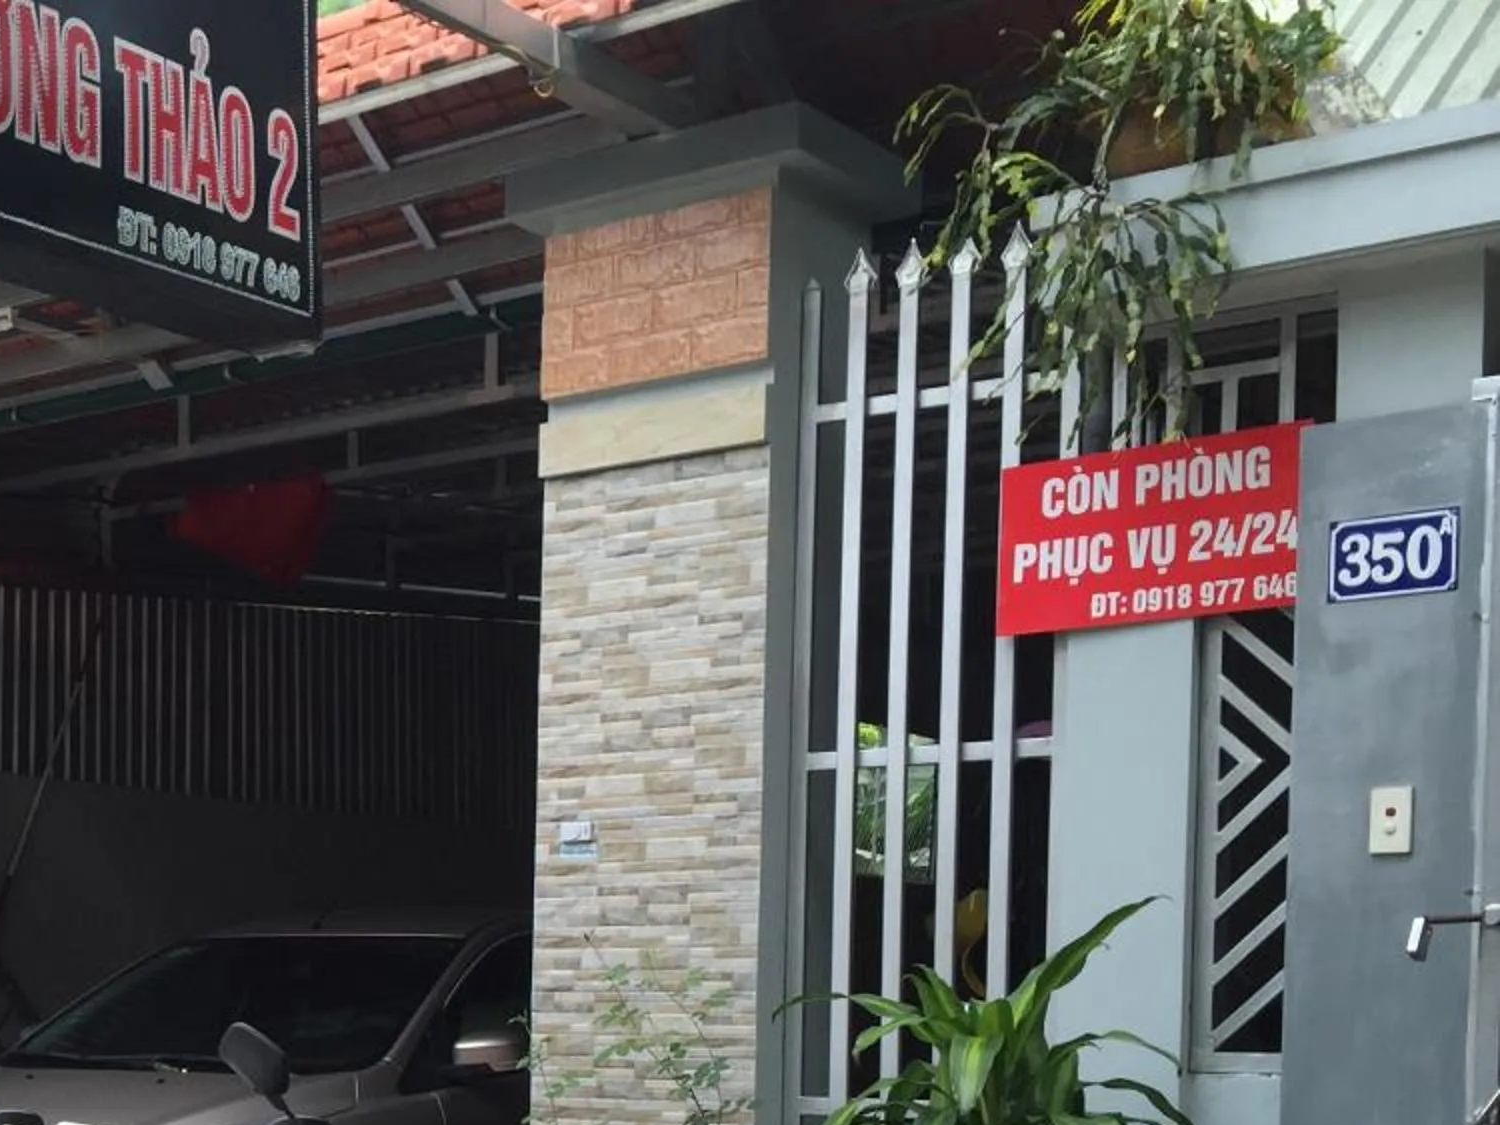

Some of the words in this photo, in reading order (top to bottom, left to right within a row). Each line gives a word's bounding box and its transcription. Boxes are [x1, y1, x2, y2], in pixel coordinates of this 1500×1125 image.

[114, 27, 256, 223] THẢO
[267, 108, 301, 241] 2
[220, 241, 260, 288] 977
[1041, 465, 1119, 519] CÒN
[1135, 446, 1271, 505] PHÒNG
[1012, 532, 1113, 586] PHỤC
[1127, 523, 1177, 575] VỤ
[1188, 509, 1298, 562] 24/24
[1132, 583, 1192, 613] 0918
[1200, 577, 1245, 607] 977
[1253, 571, 1298, 599] 646
